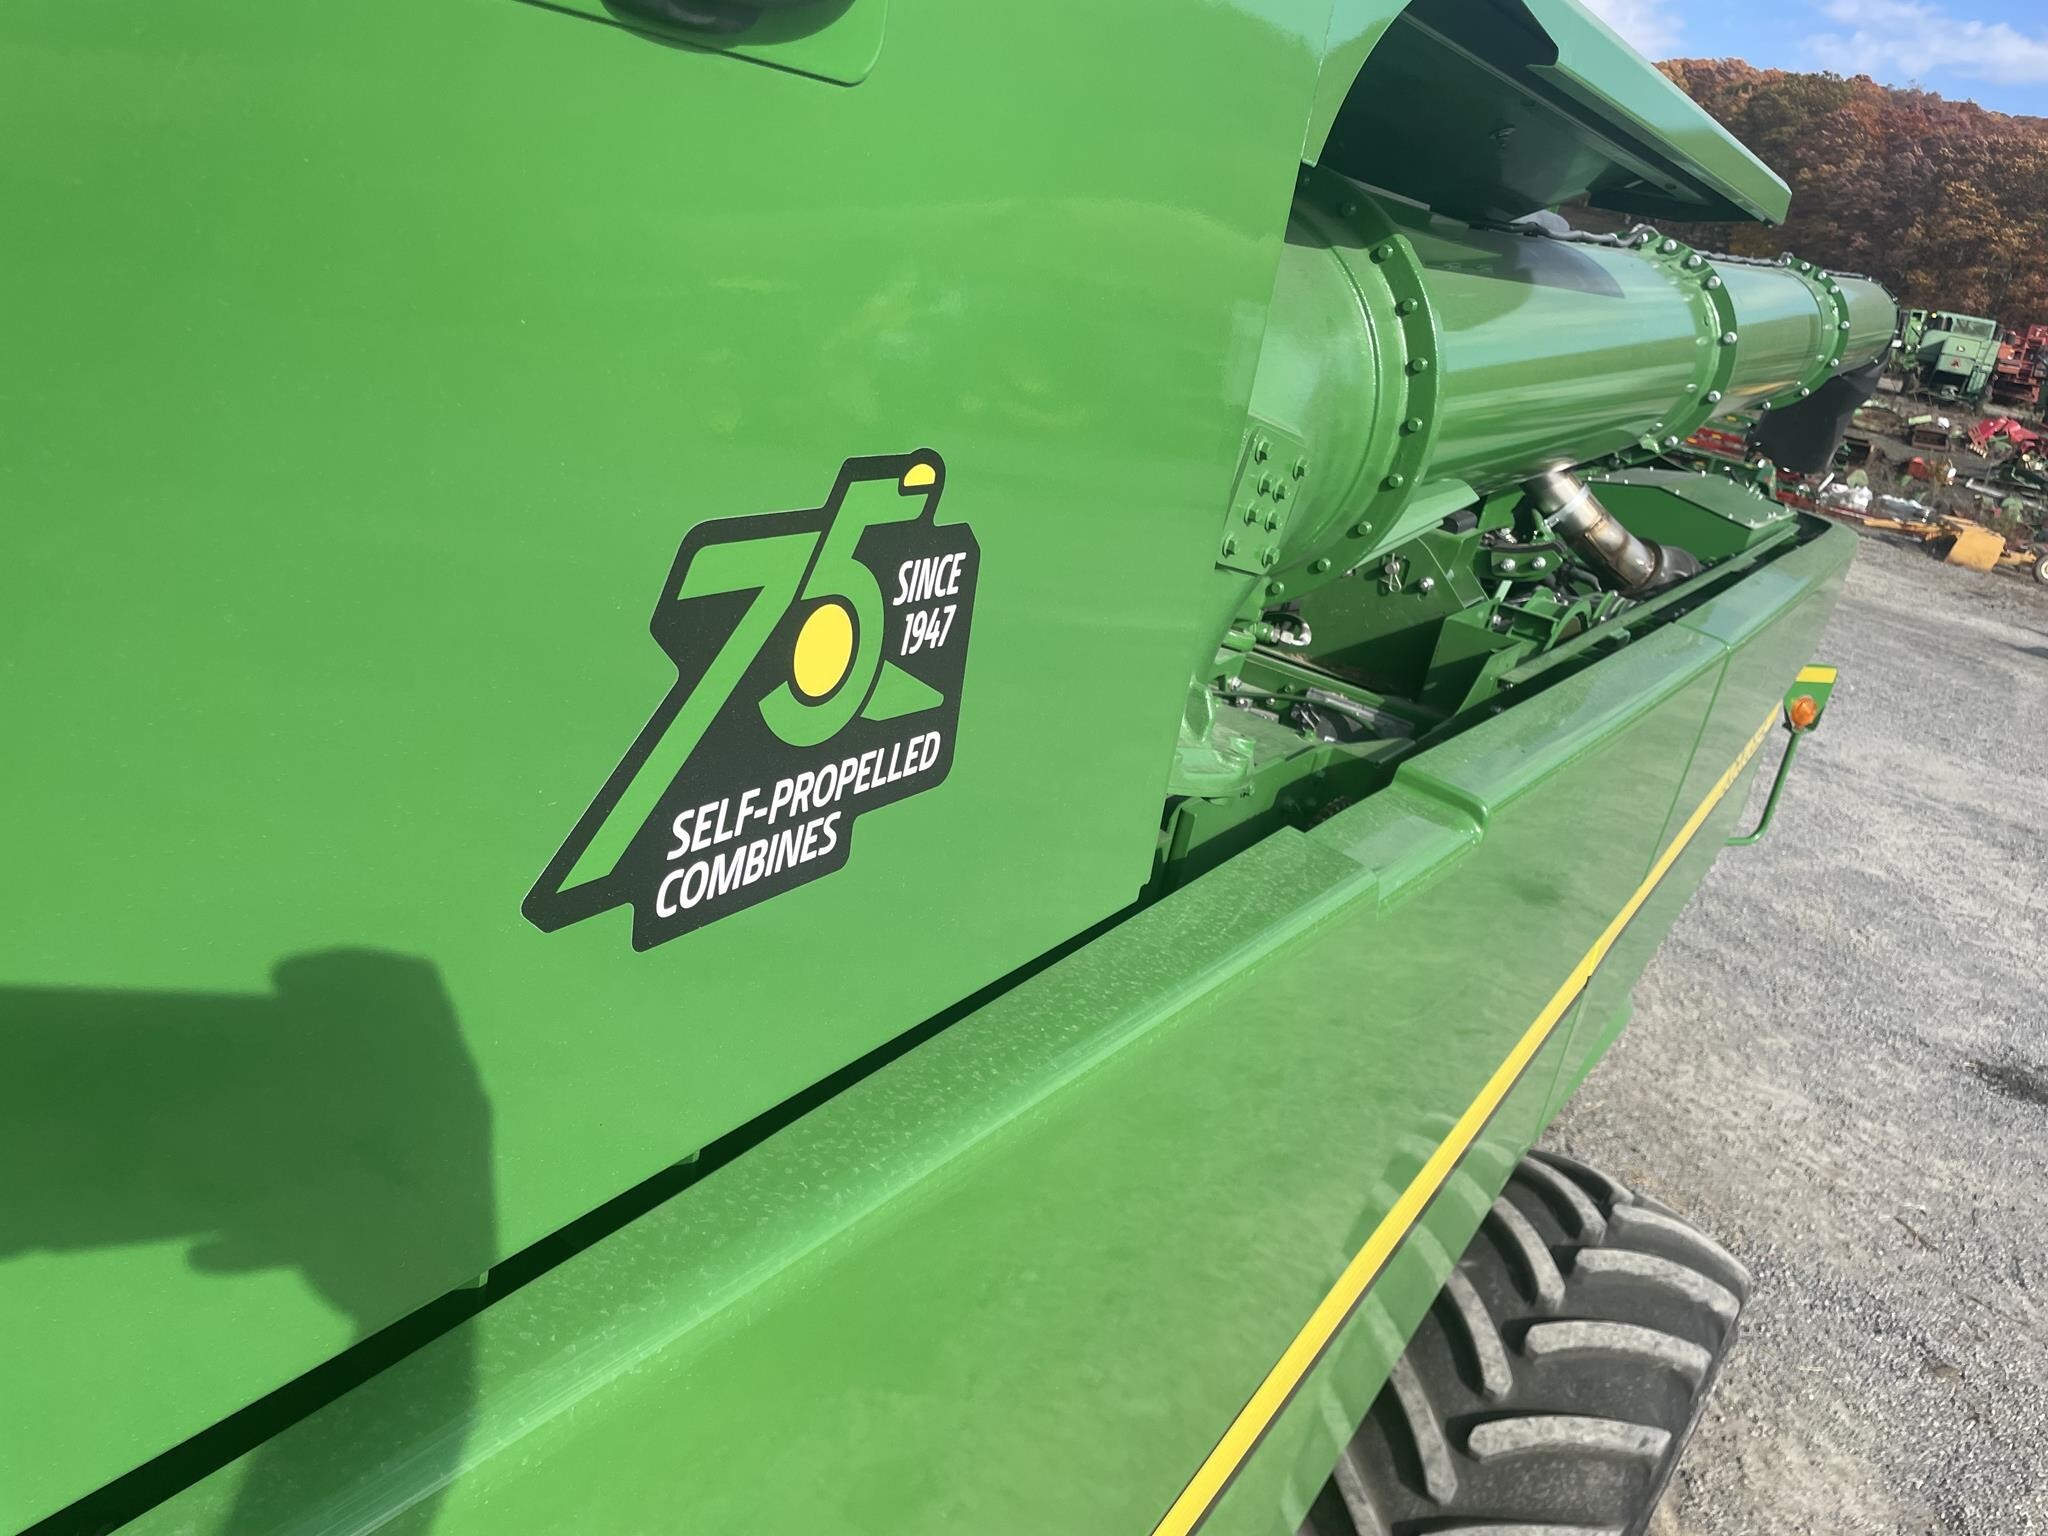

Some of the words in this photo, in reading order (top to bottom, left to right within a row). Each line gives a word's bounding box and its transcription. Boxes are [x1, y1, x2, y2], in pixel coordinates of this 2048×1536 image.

[892, 551, 967, 606] SINCE
[900, 603, 957, 656] 1947
[666, 730, 941, 861] SELF-PROPELLED
[655, 810, 842, 919] COMBINES
